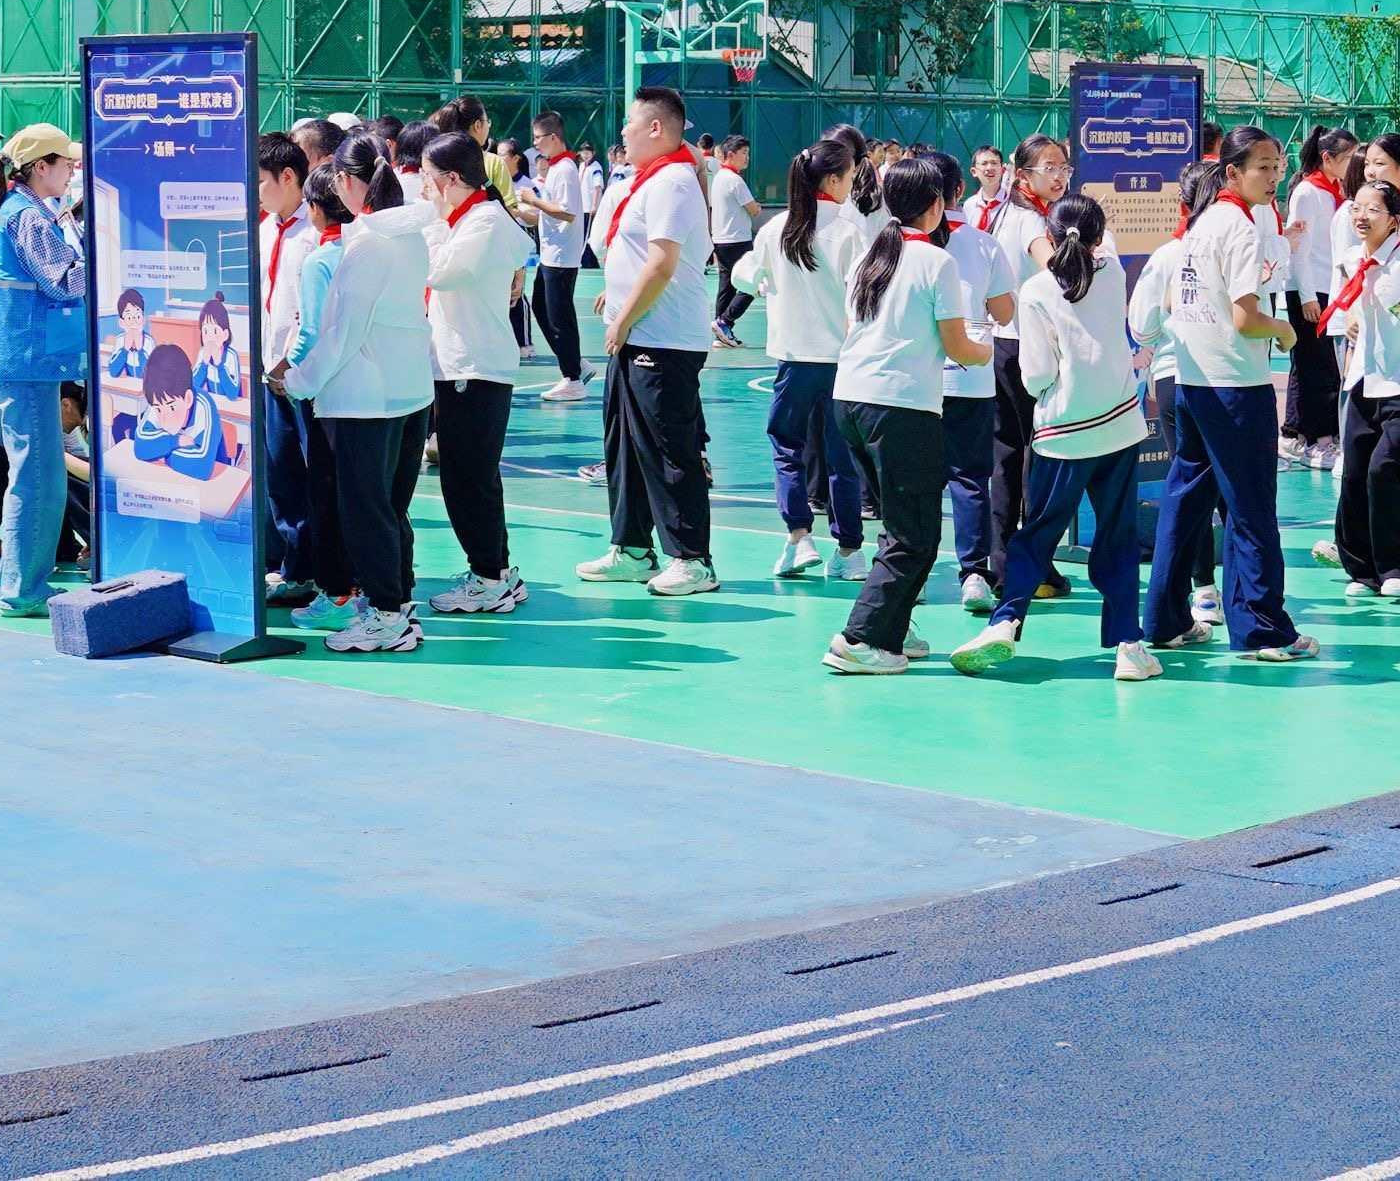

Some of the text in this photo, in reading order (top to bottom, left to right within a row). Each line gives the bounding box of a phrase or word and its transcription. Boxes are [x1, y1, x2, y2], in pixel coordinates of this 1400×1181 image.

[153, 141, 186, 157] 场景一
[1130, 177, 1147, 189] 背景
